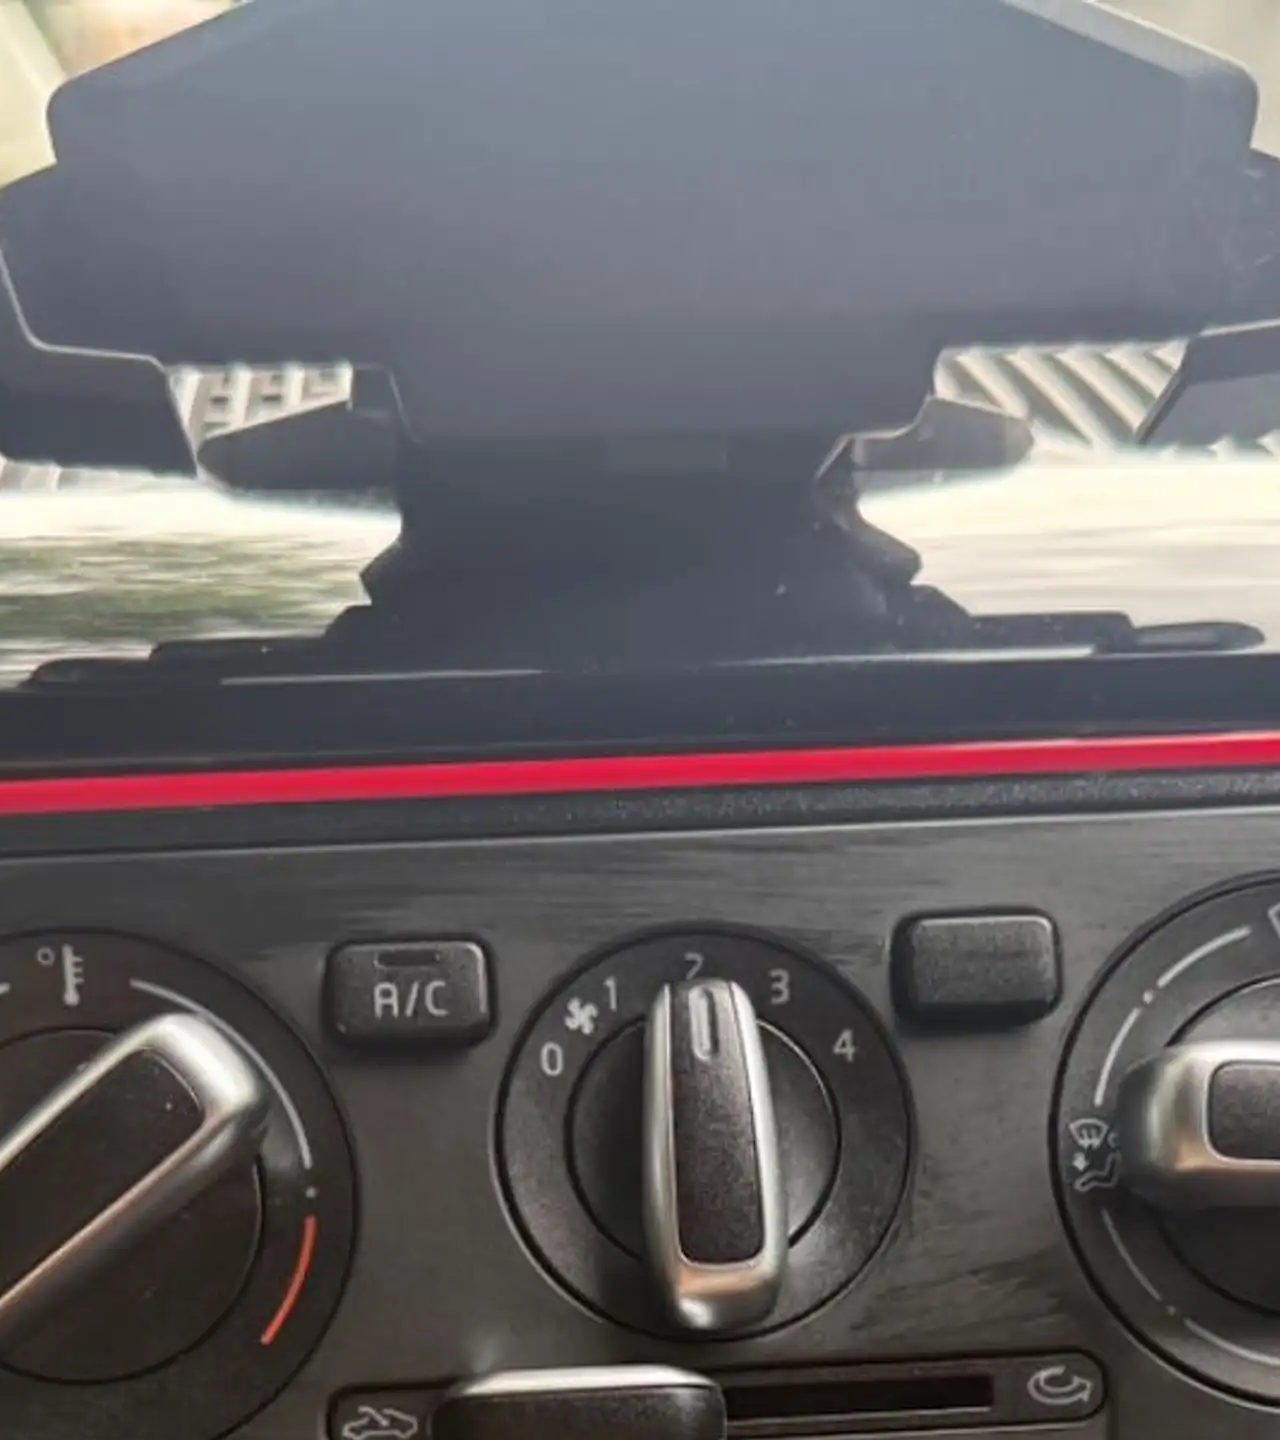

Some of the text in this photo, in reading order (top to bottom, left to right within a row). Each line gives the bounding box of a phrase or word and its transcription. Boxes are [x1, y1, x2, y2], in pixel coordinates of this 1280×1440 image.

[372, 982, 450, 1018] A/C
[539, 1043, 563, 1077] 0
[604, 976, 620, 1010] 1
[769, 969, 791, 1005] 3
[832, 1029, 856, 1063] 4
